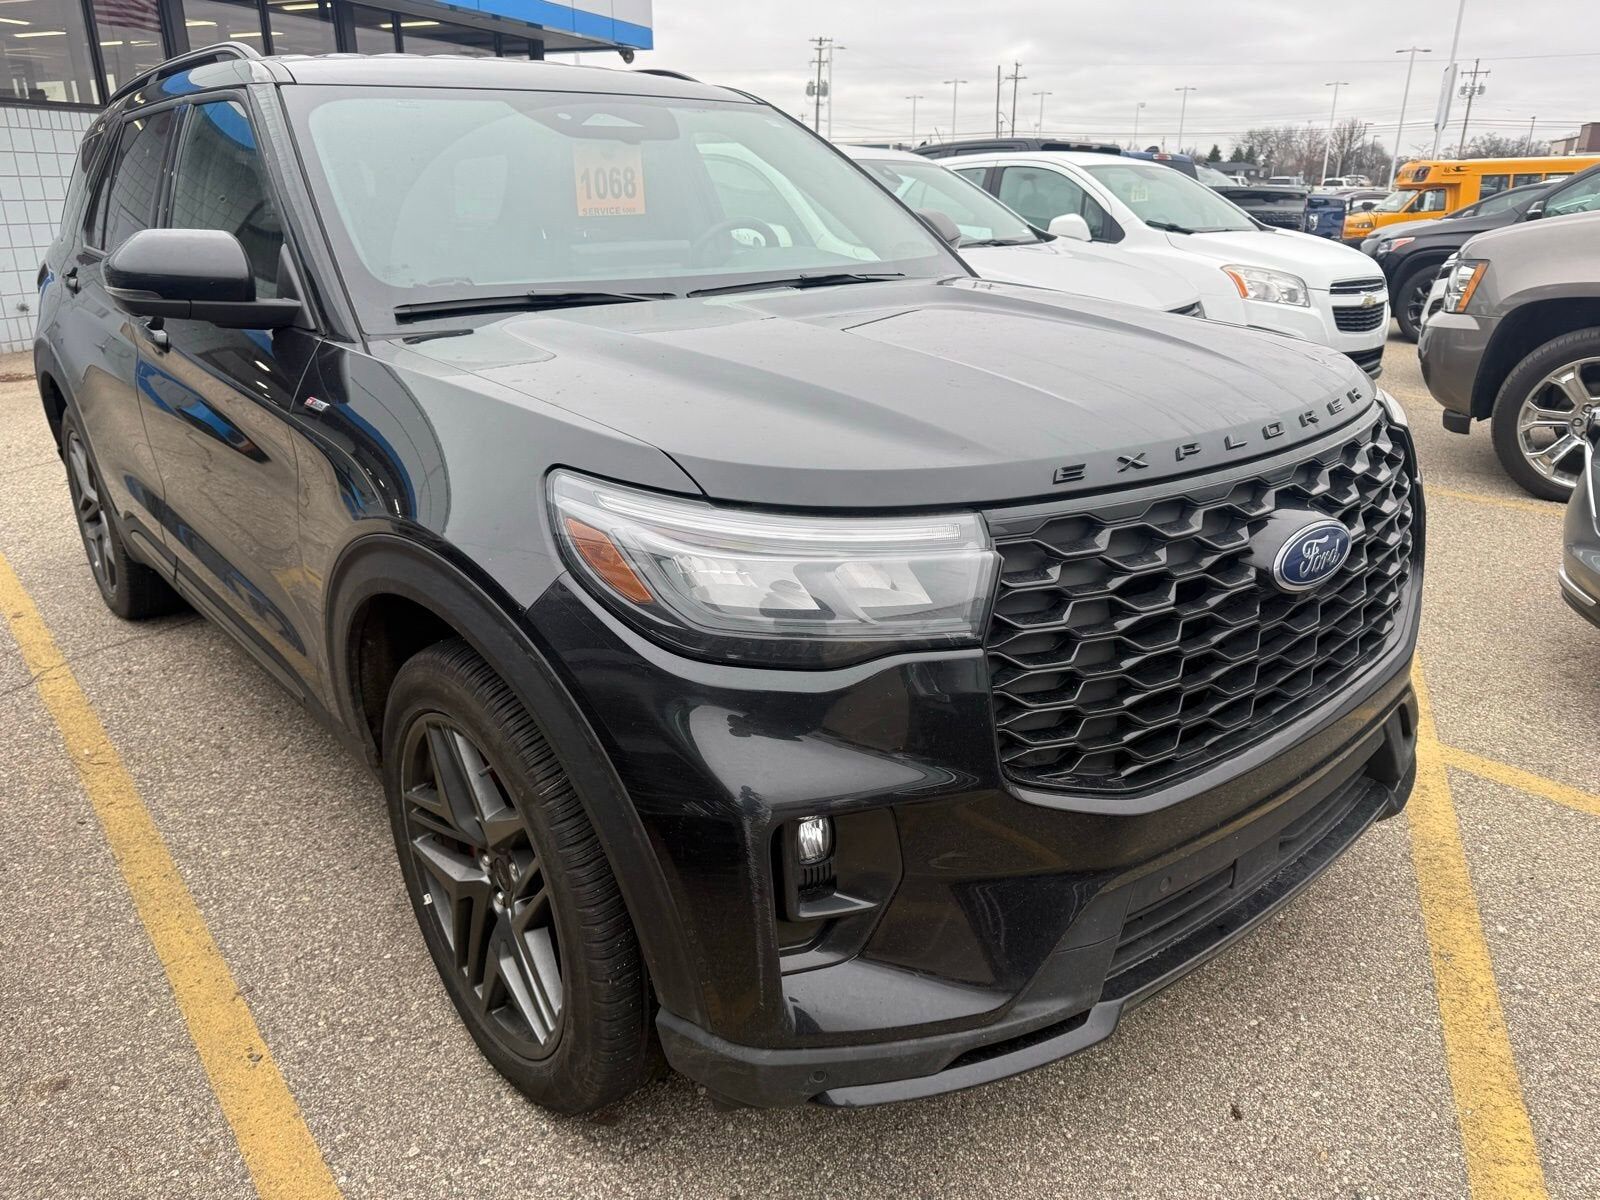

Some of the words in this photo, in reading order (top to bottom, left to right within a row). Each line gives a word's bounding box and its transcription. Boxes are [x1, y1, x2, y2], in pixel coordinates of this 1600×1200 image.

[580, 166, 637, 200] 1068
[582, 206, 621, 216] SERVICE
[1052, 386, 1363, 485] EXPLORER
[1299, 534, 1340, 579] Ford
